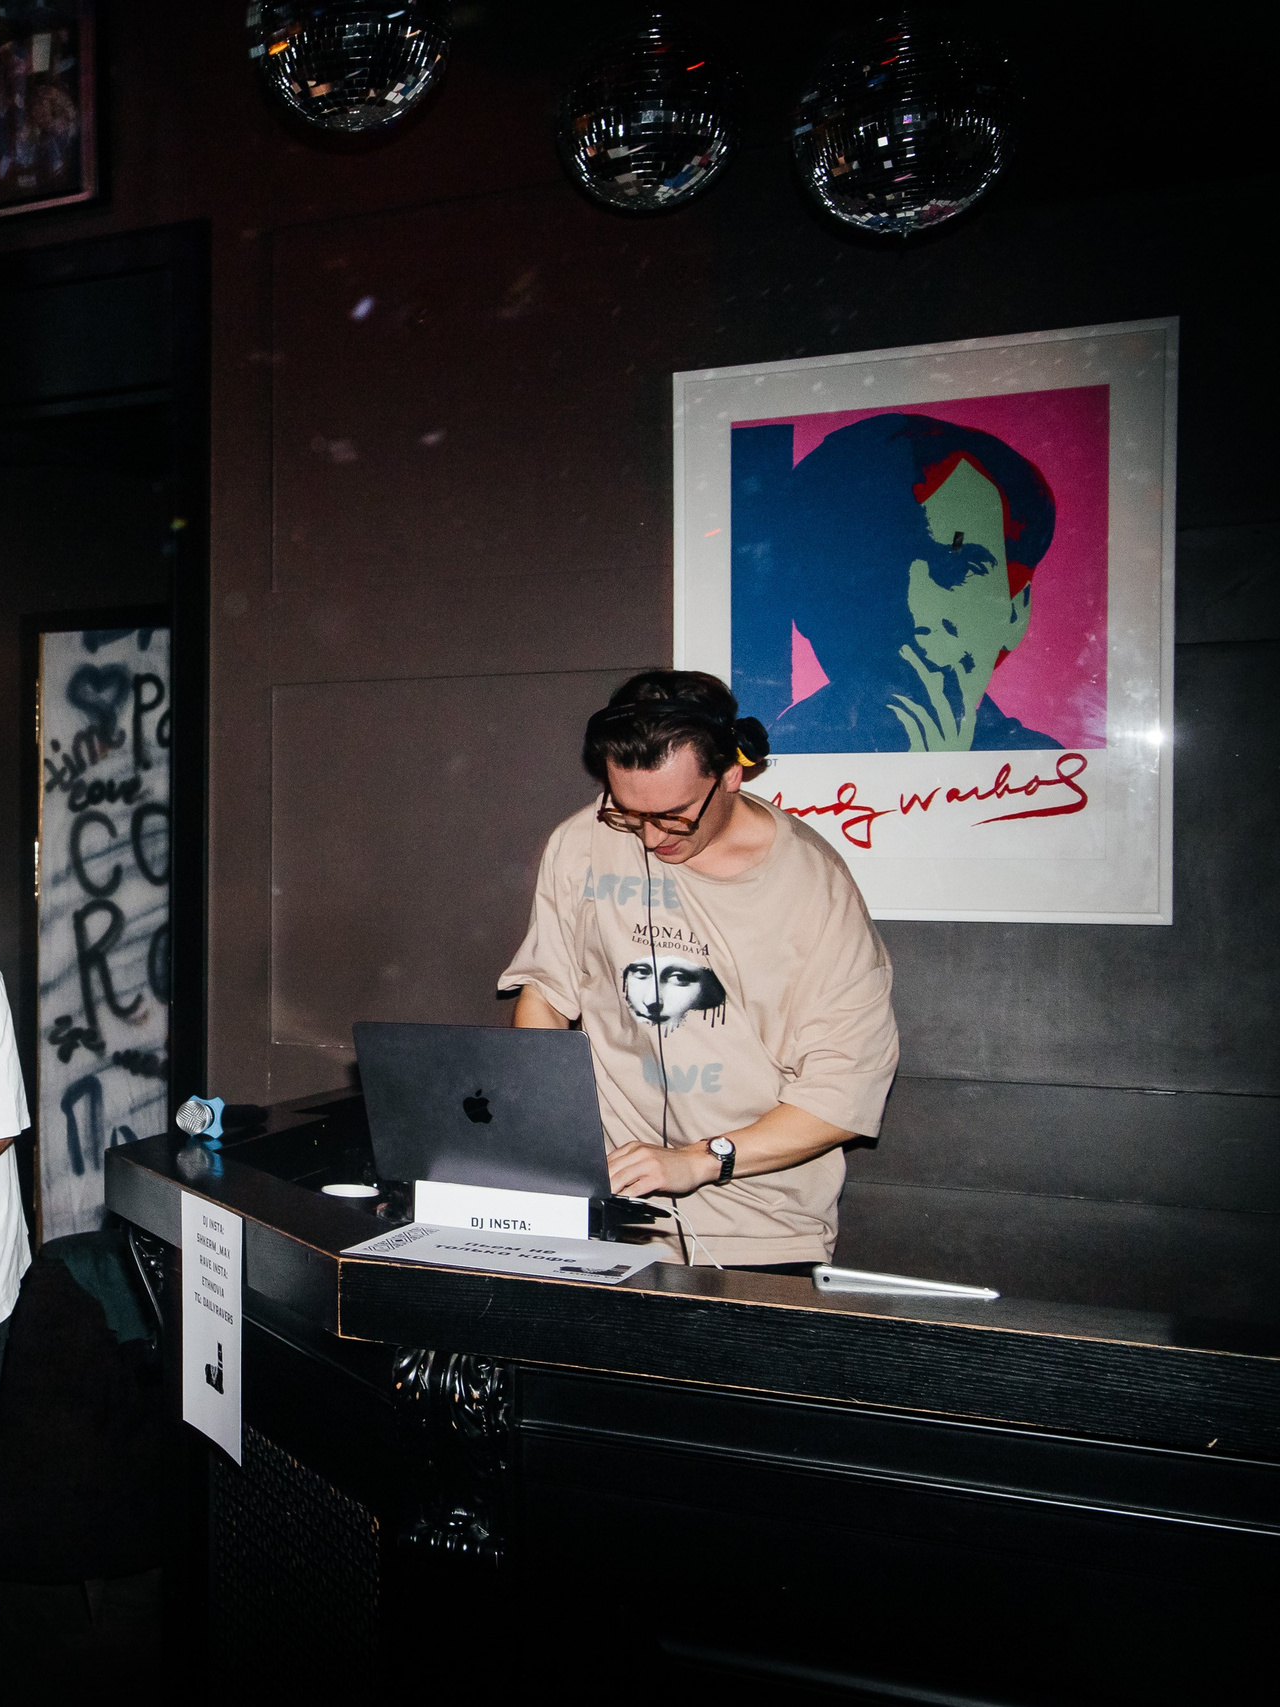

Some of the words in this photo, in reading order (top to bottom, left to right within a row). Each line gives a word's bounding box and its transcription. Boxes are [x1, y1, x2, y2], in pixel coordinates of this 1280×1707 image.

[633, 923, 683, 941] MONA
[203, 1215, 208, 1228] DJ
[209, 1218, 225, 1235] INSTA:
[470, 1217, 484, 1229] DJ
[489, 1218, 532, 1231] INSTA:
[200, 1254, 212, 1270] RAVE
[213, 1262, 228, 1279] INSTA:
